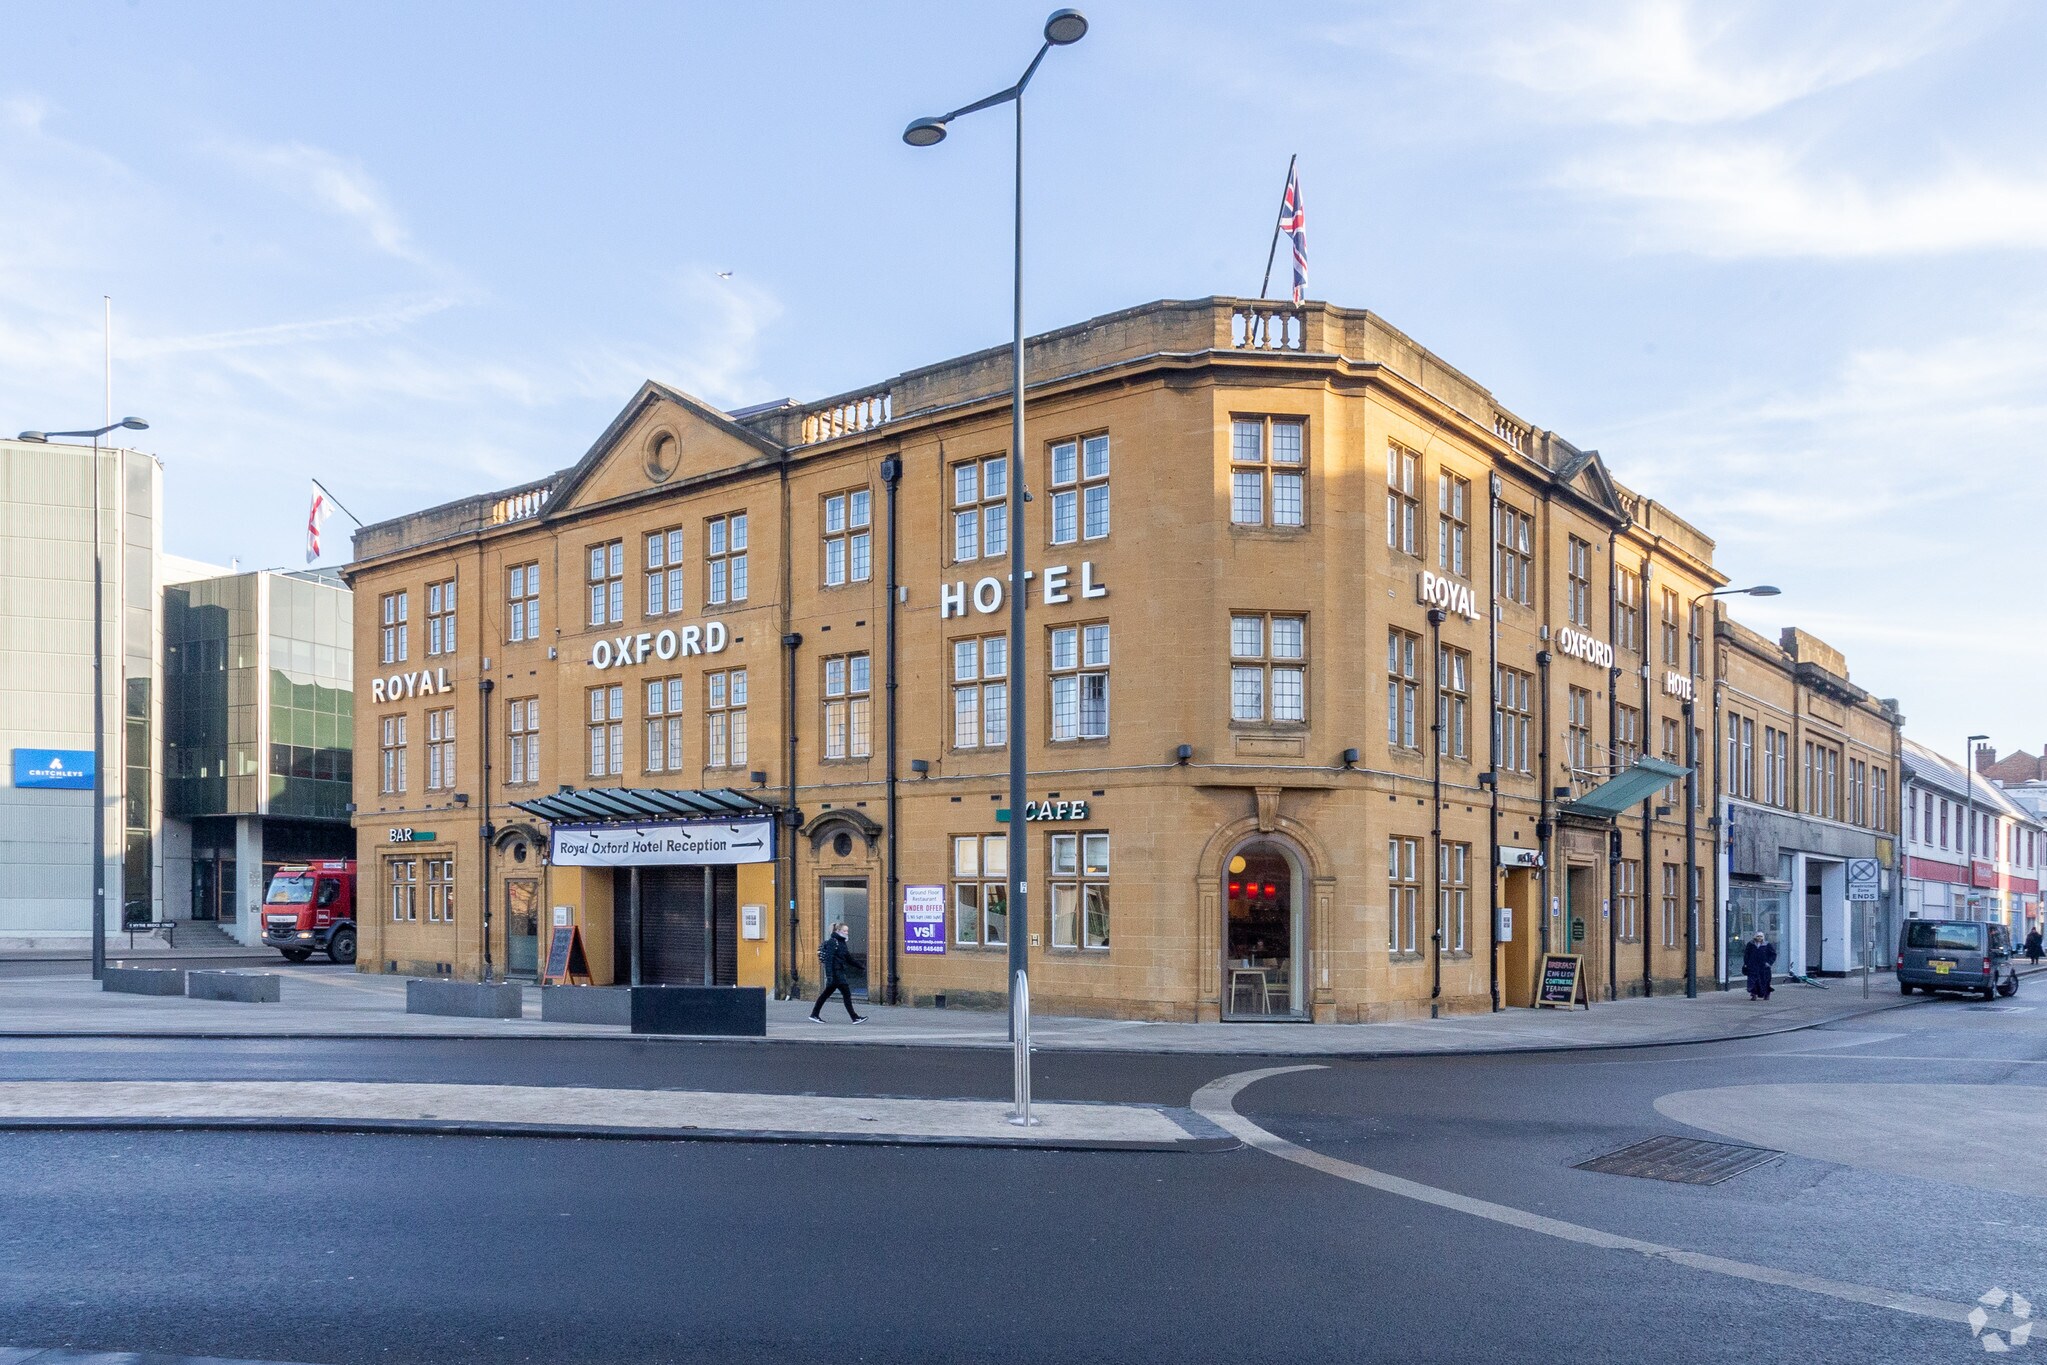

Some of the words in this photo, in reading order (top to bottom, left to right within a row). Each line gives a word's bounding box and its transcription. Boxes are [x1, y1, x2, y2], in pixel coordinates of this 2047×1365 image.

[1423, 570, 1480, 620] ROYAL
[592, 621, 727, 670] OXFORD
[1561, 626, 1613, 669] OXFORD
[372, 667, 452, 704] ROYAL
[28, 769, 83, 777] CRITCHLEYS
[1025, 800, 1085, 821] CAFE
[389, 827, 413, 842] BAR
[560, 842, 588, 856] Royal
[591, 841, 629, 855] Oxford
[631, 840, 663, 853] Hotel
[666, 838, 727, 854] Reception
[905, 904, 924, 912] UNDER
[926, 904, 943, 912] OFFER
